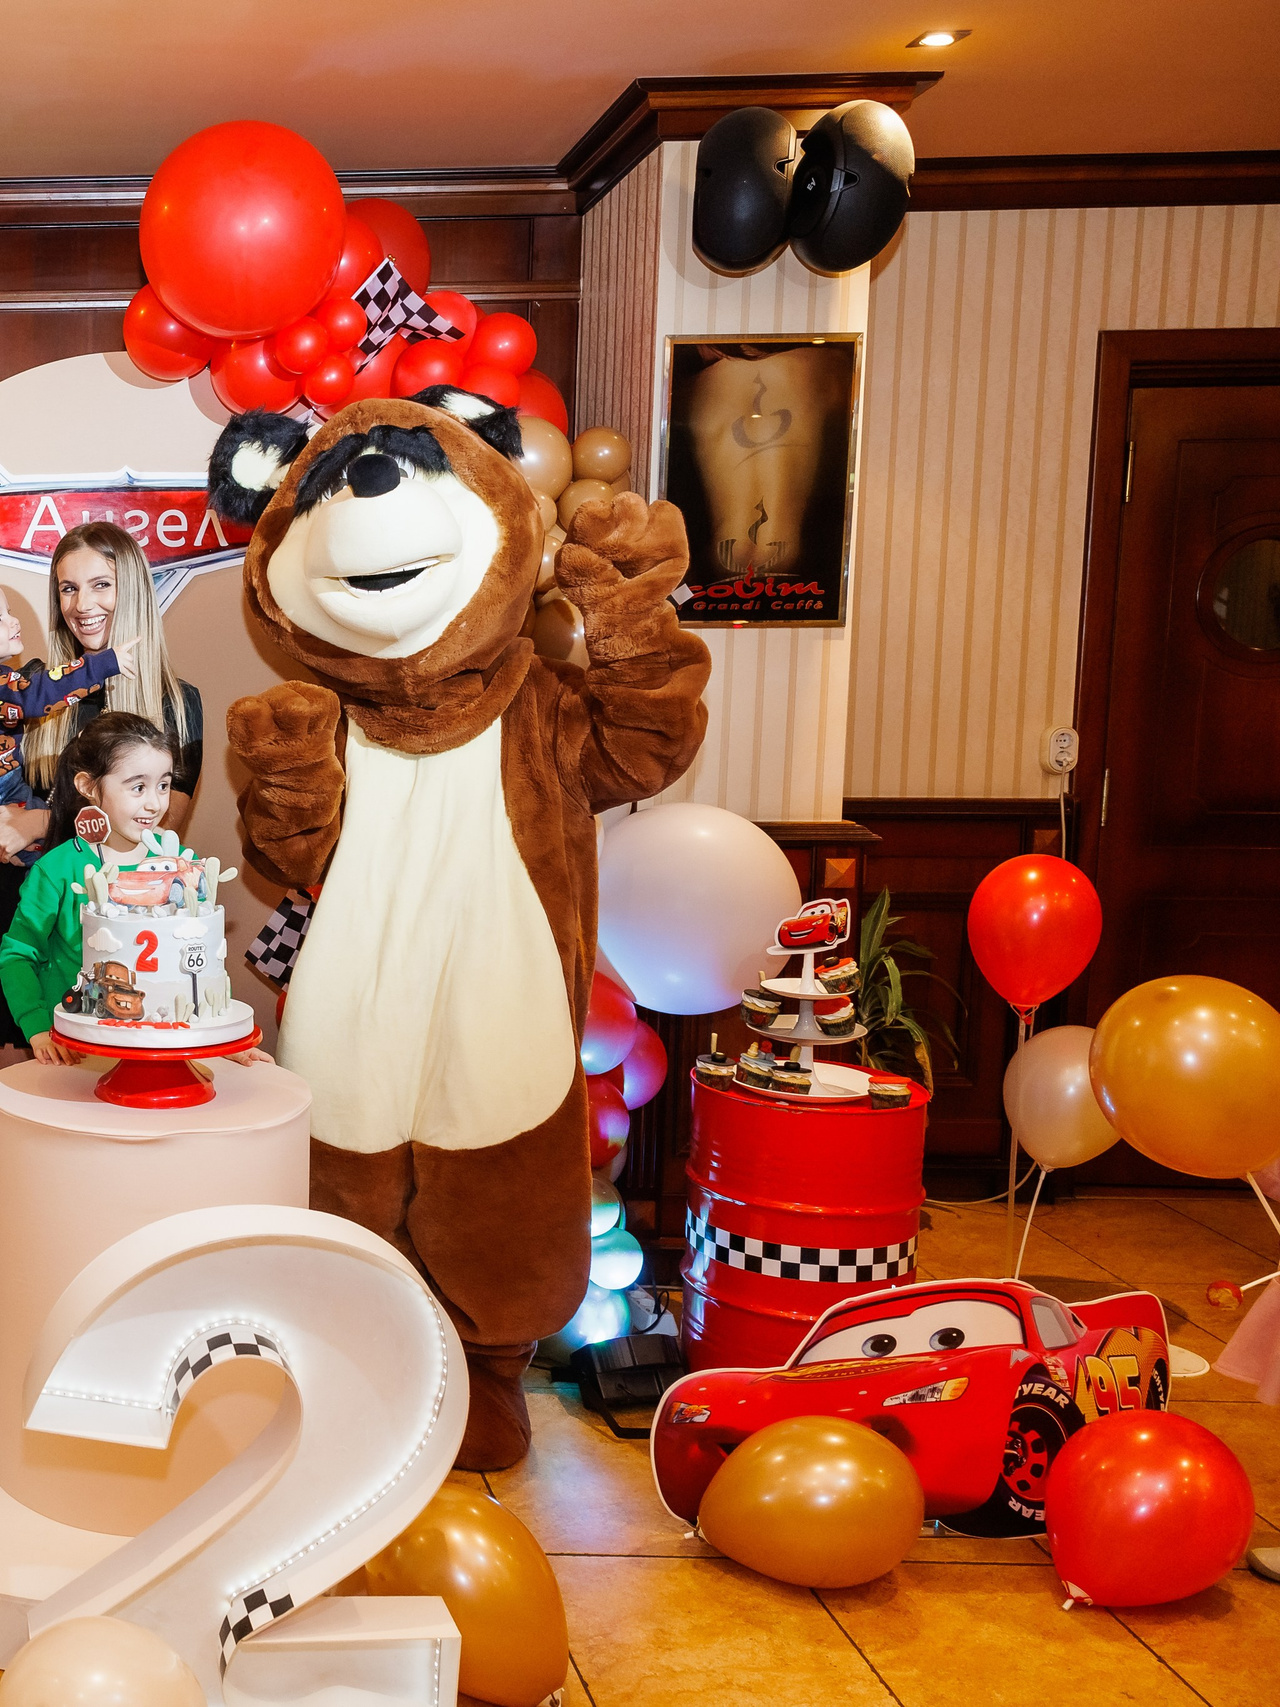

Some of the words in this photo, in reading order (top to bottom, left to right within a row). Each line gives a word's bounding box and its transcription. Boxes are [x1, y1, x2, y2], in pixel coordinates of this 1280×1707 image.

[692, 600, 761, 611] Grandi
[78, 818, 105, 835] STOP
[135, 930, 159, 972] 2
[187, 953, 204, 968] 66
[1084, 1355, 1141, 1415] 95
